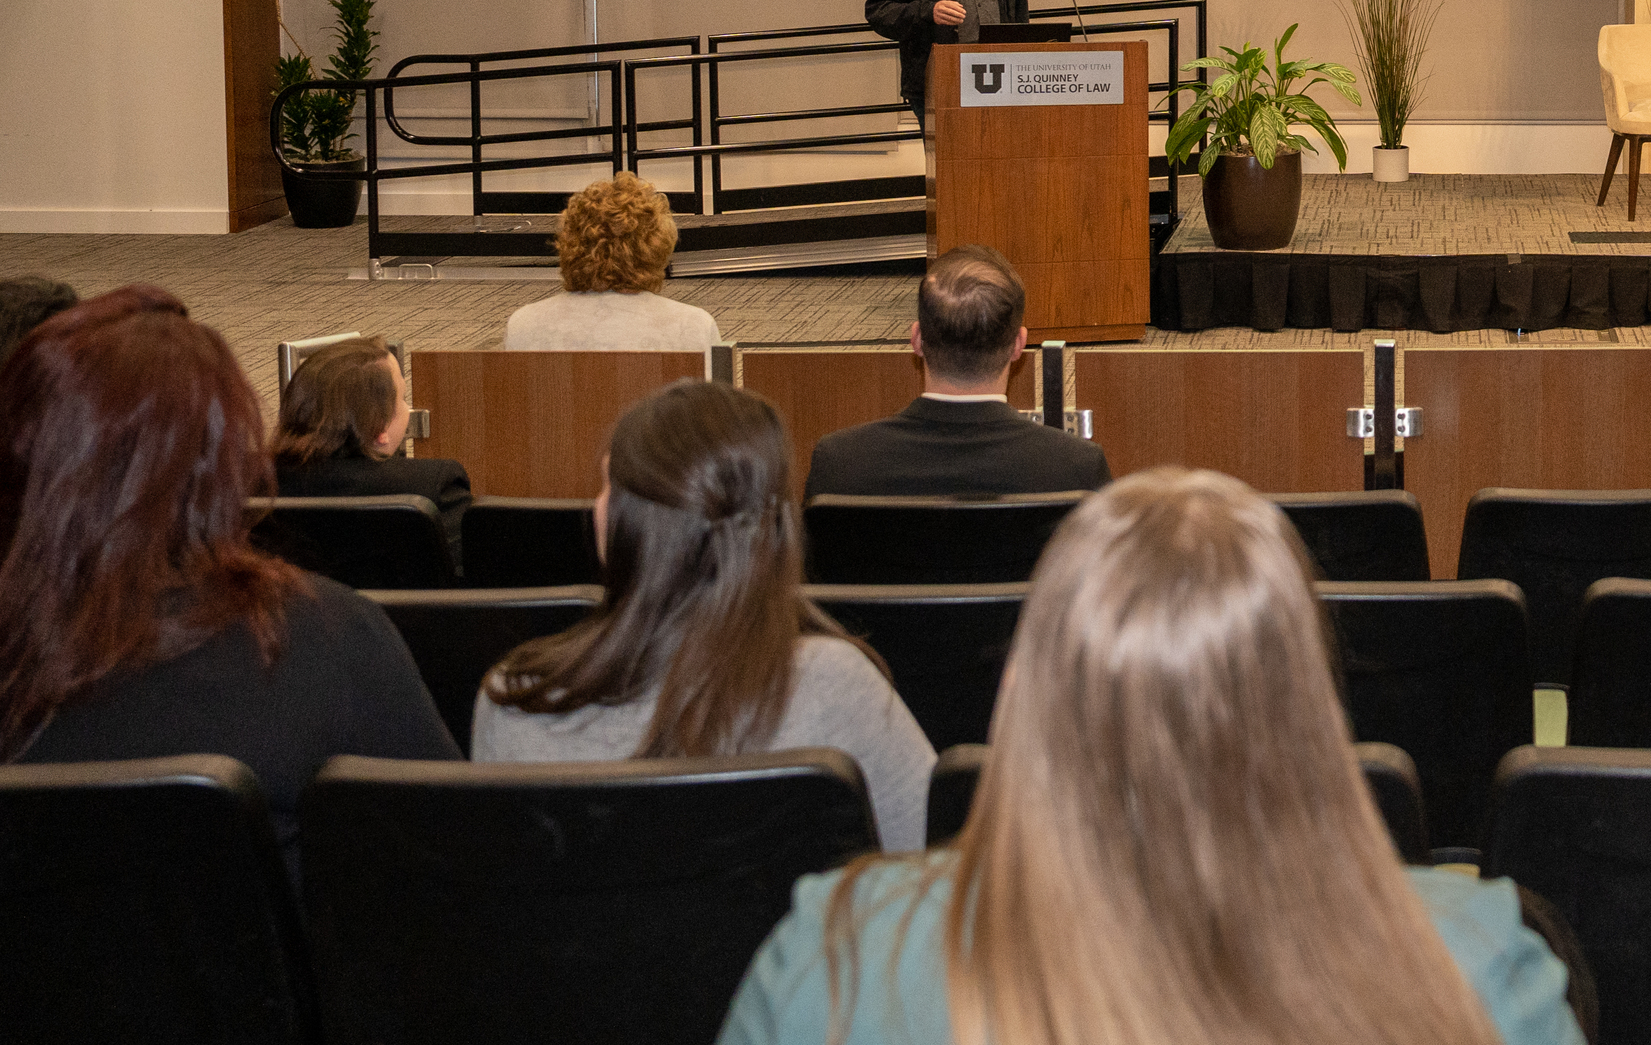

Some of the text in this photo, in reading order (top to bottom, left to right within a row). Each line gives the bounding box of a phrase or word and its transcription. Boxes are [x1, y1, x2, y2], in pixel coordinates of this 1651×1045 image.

[1016, 63, 1112, 72] THE UNIVERSITY OF UTAH
[1017, 73, 1079, 84] S.J. QUINNEY
[1017, 83, 1111, 95] COLLEGE OF LAW
